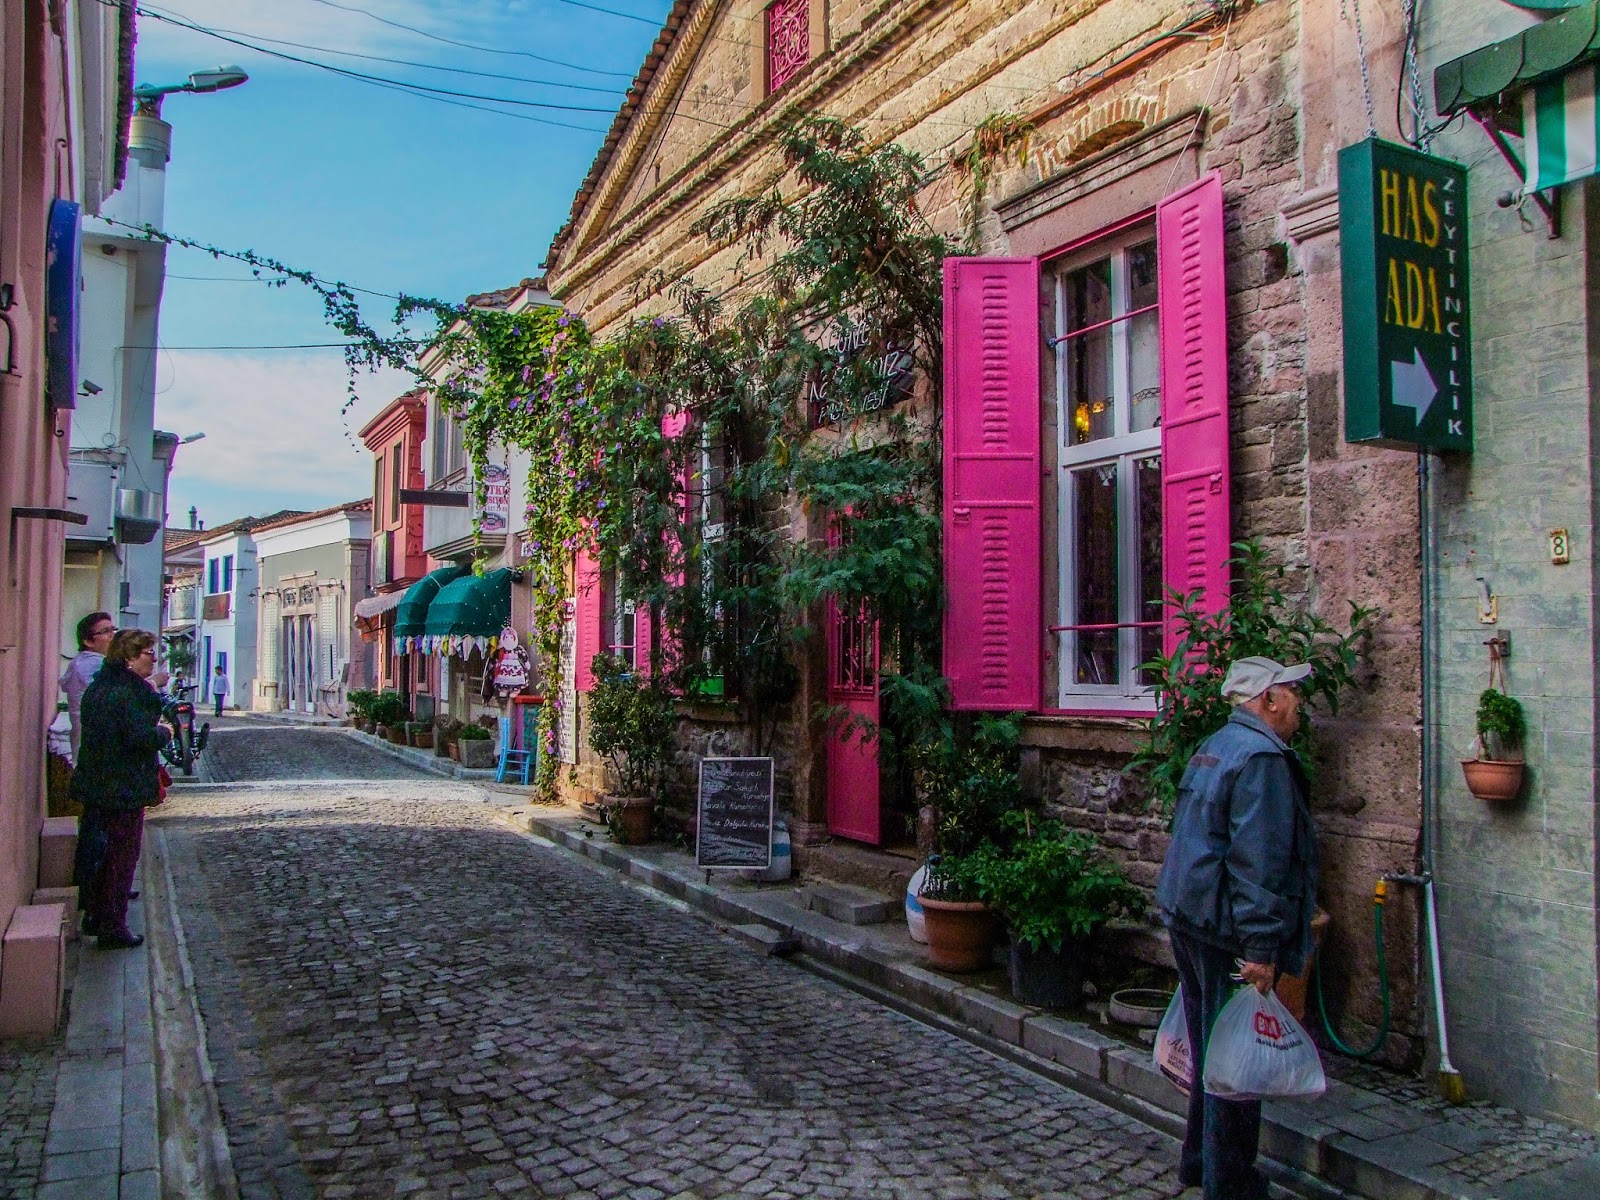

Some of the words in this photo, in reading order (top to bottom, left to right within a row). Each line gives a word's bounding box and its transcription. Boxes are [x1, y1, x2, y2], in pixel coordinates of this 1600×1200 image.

[1380, 167, 1441, 249] HAS
[1384, 256, 1442, 335] ADA
[1553, 536, 1565, 556] 8
